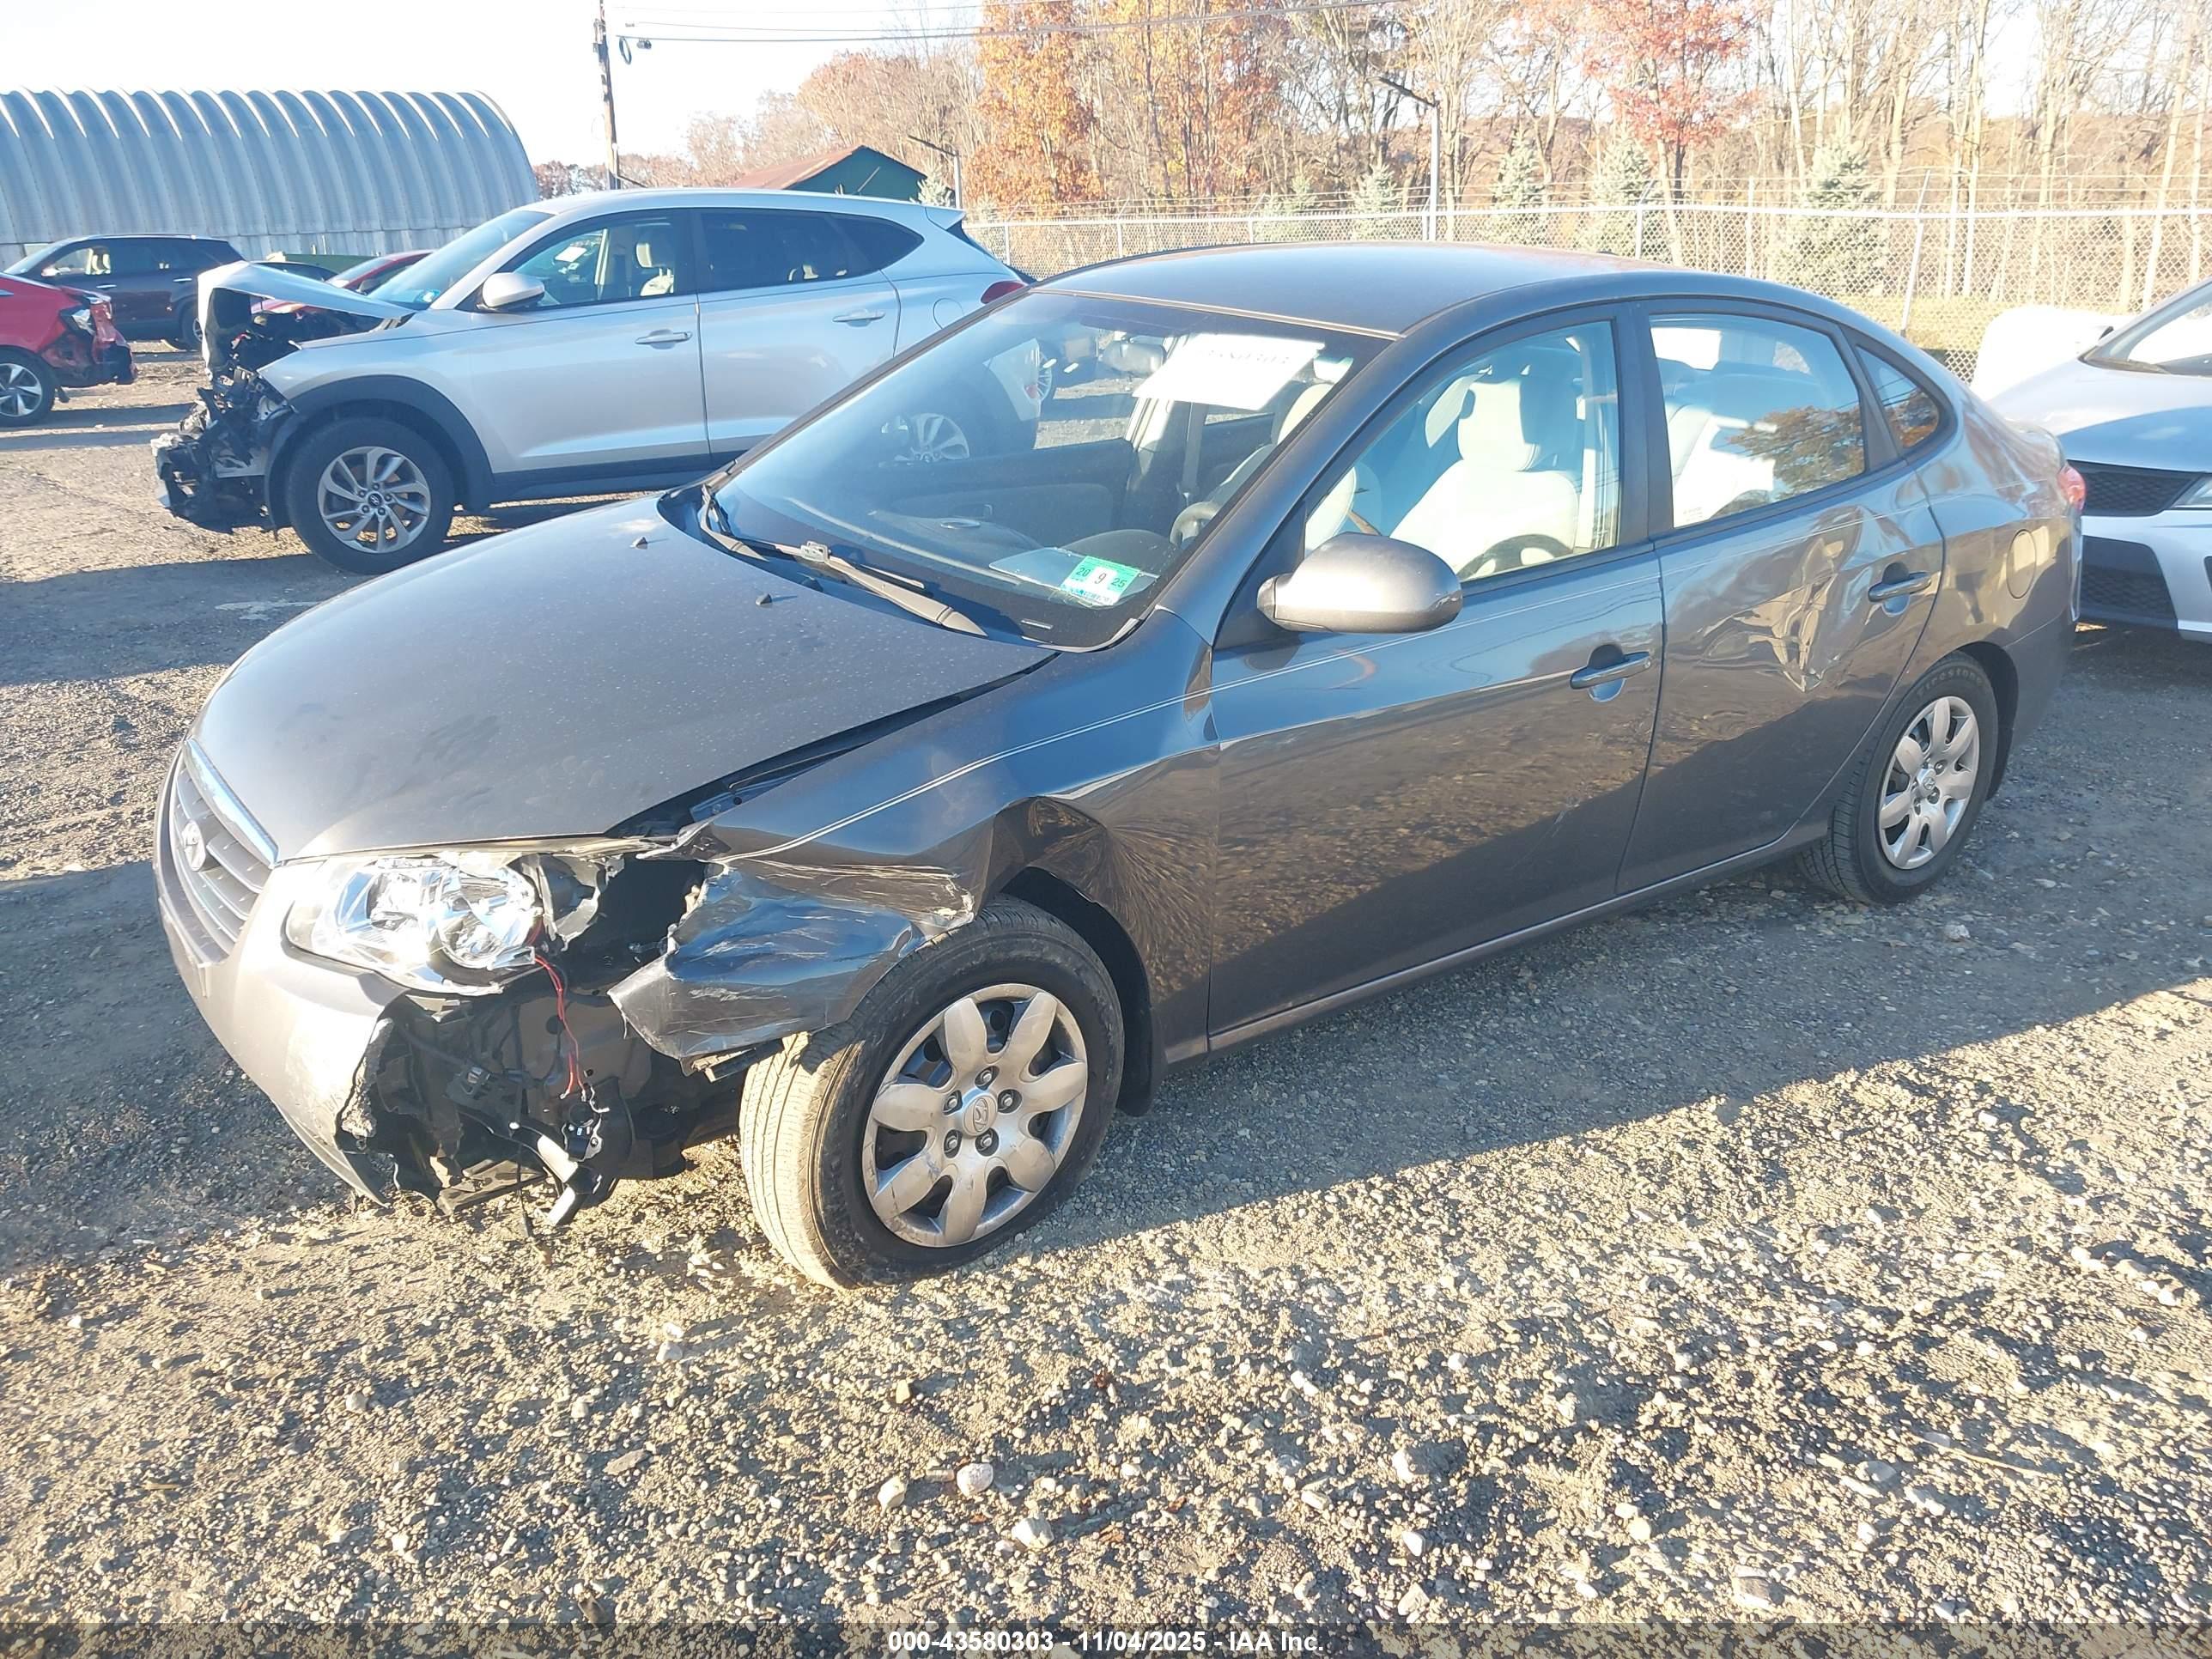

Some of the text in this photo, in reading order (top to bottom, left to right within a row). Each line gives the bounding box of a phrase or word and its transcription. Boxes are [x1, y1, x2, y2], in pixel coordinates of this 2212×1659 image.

[1076, 568, 1127, 587] 20 9 25
[1916, 667, 1983, 698] Firestone
